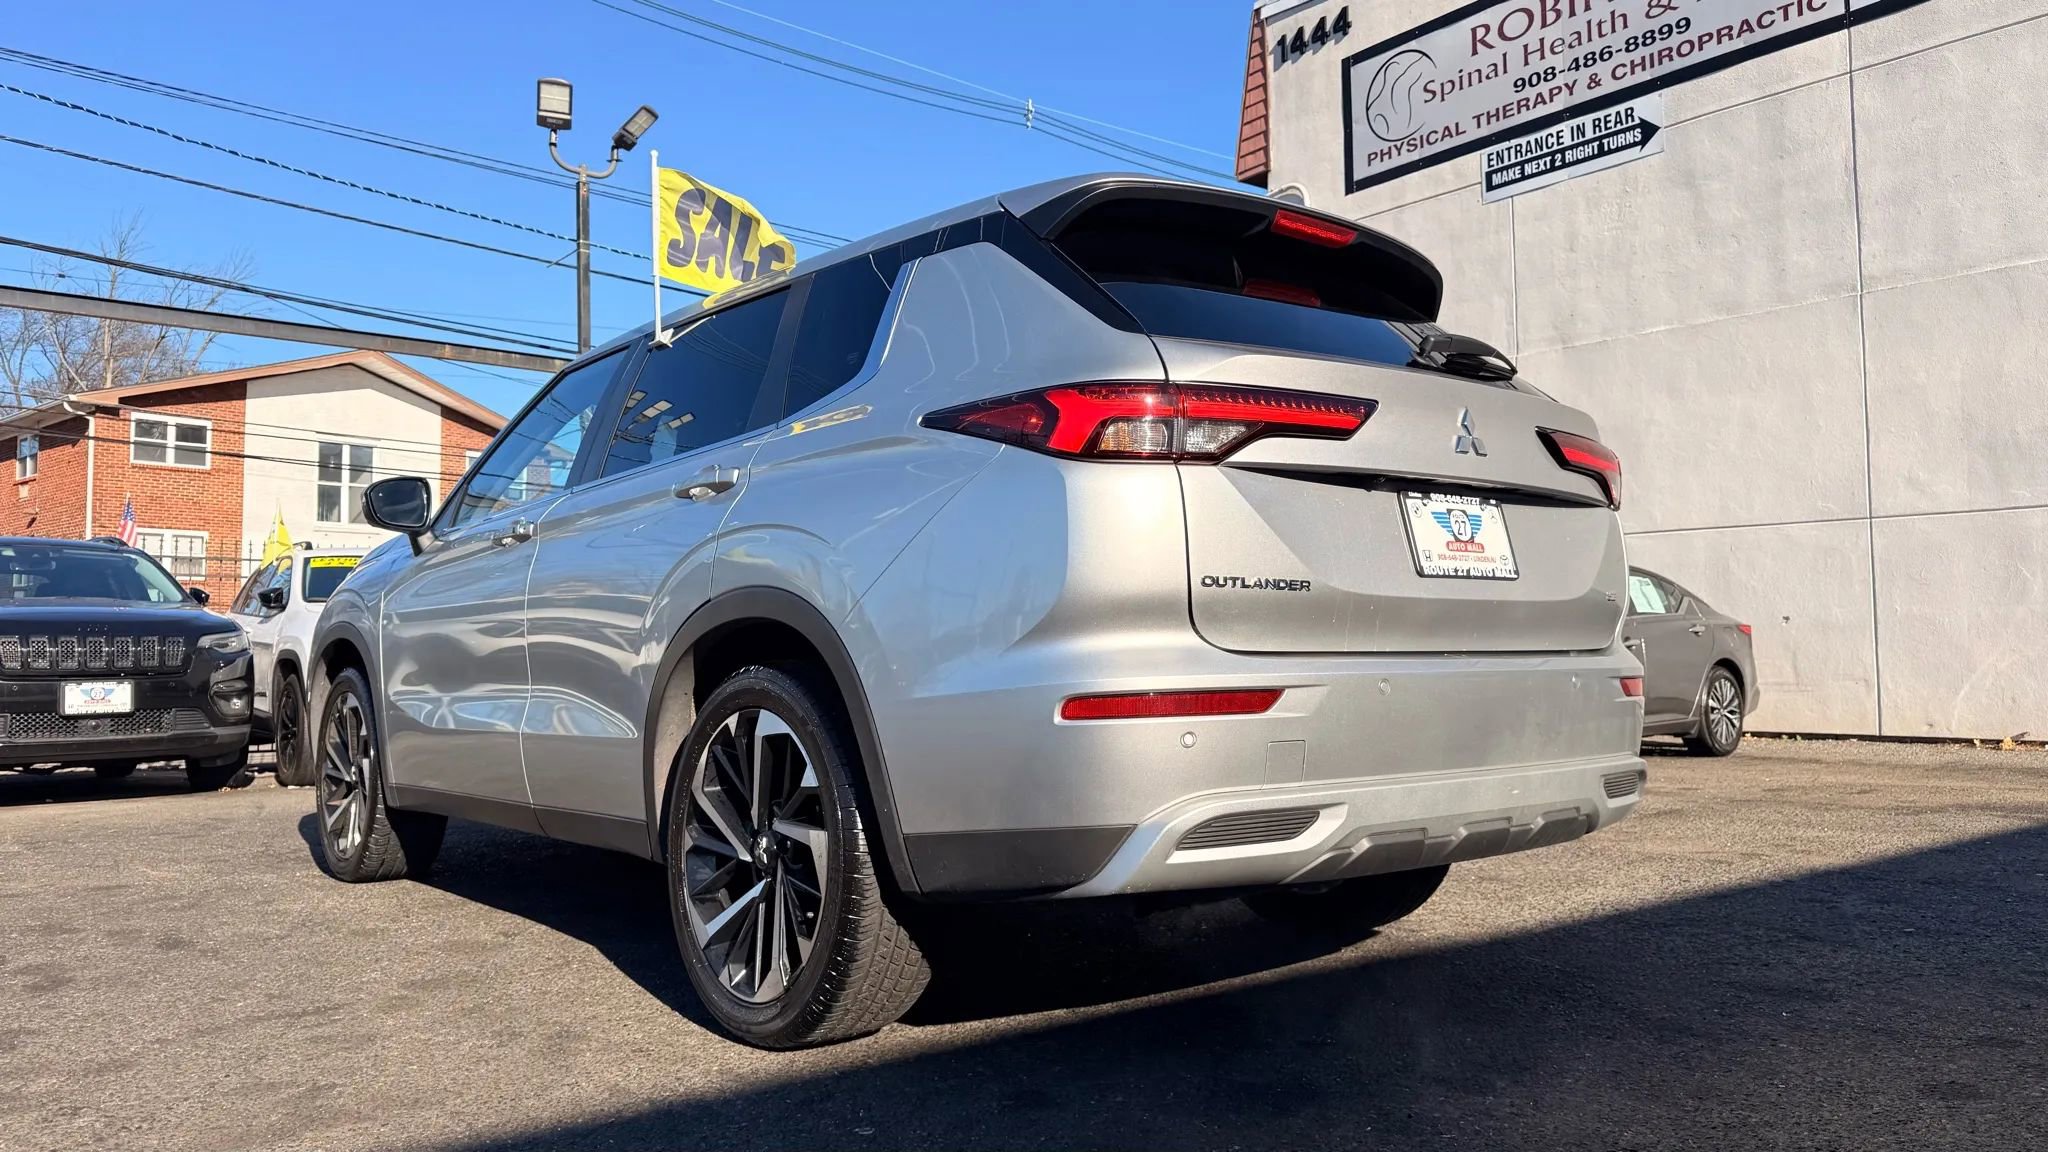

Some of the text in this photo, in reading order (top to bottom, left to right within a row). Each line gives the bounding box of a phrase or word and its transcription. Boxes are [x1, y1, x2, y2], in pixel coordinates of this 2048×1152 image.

[1277, 5, 1351, 63] 1444
[1423, 51, 1508, 103] Spinal
[1523, 9, 1629, 67] Health
[1470, 0, 1613, 57] ROBI
[1513, 16, 1691, 94] 908-486-8899
[1367, 122, 1466, 167] PHYSICAL
[1472, 79, 1578, 129] THERAPY
[1587, 72, 1602, 91] &
[1487, 106, 1635, 169] ENTRANCE IN REAR
[1492, 128, 1642, 186] MAKE NEXT 2 RIGHT TURNS
[1448, 543, 1484, 552] AUTO MALL
[1455, 520, 1467, 537] 27
[1201, 575, 1311, 592] OUTLANDER
[1424, 565, 1456, 575] ROUTE
[1457, 566, 1467, 576] 27
[1469, 566, 1491, 577] AUTO
